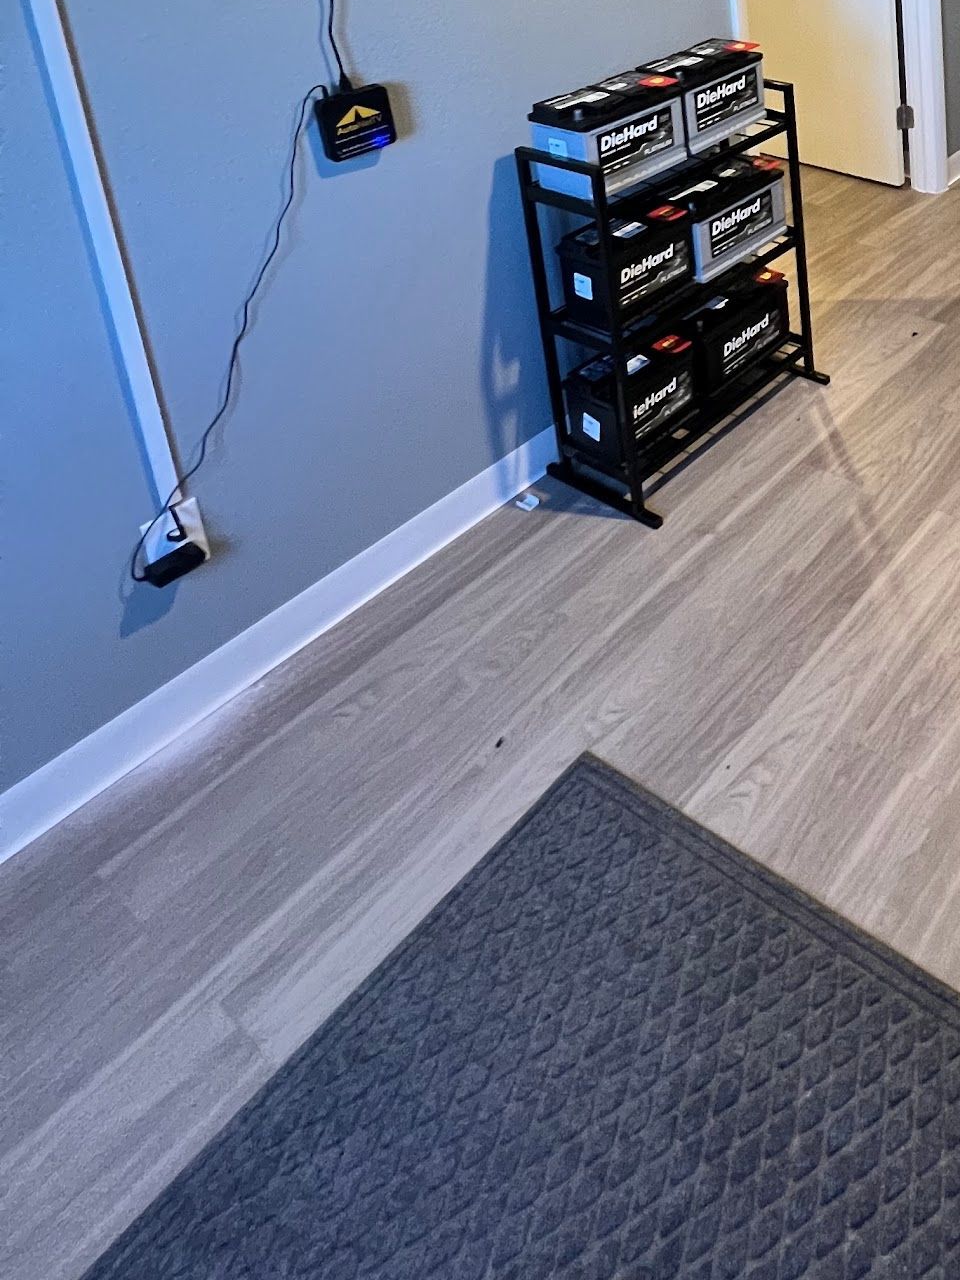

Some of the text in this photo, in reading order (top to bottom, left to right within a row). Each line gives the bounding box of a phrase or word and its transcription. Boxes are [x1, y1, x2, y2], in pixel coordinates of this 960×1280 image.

[696, 74, 746, 109] DieHard
[600, 114, 658, 152] DieHard
[711, 197, 761, 236] DieHard
[620, 242, 674, 284] DieHard
[723, 313, 770, 357] DieHard
[632, 376, 677, 419] ieHard
